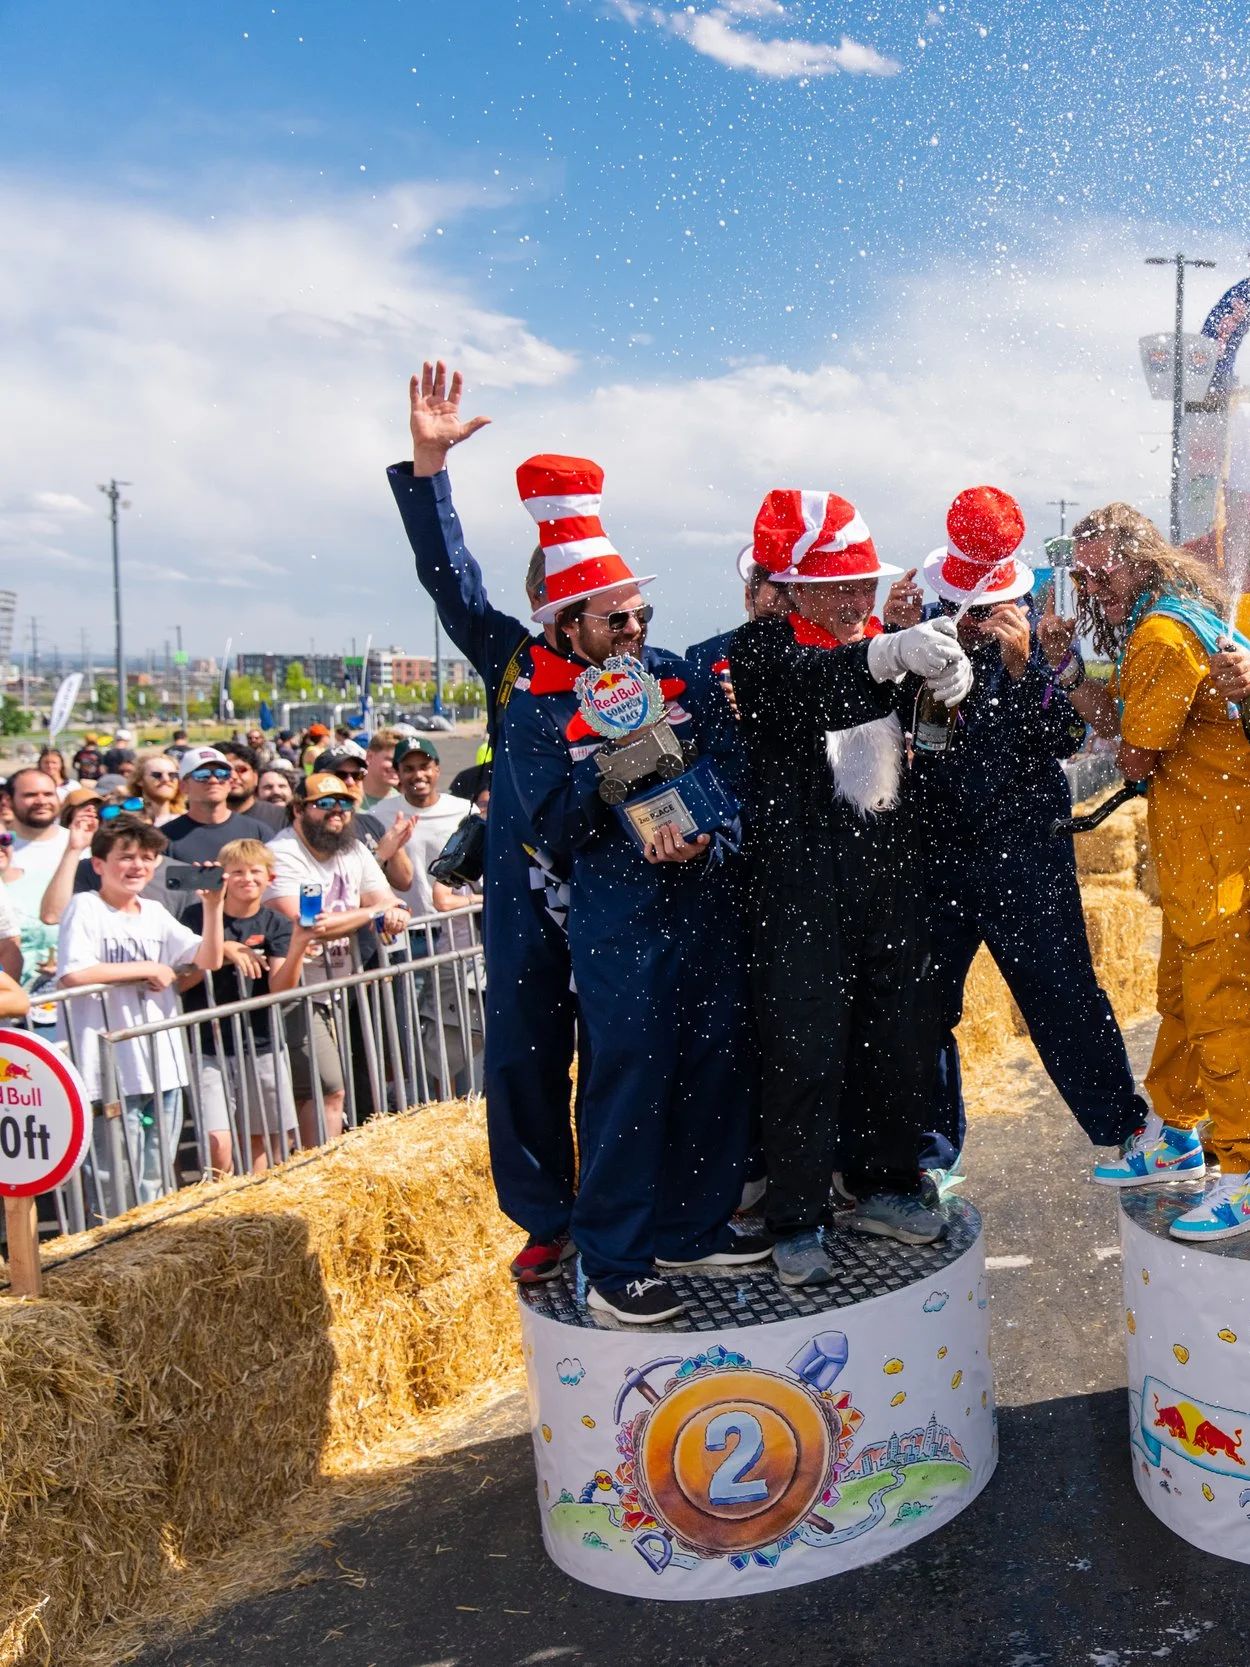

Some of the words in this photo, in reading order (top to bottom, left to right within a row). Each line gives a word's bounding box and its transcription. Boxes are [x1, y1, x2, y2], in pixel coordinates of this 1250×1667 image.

[593, 691, 619, 711] Red
[617, 680, 643, 700] Bull
[606, 696, 642, 718] SOAPBOX
[620, 710, 640, 723] RACE
[650, 804, 675, 819] PLACE
[7, 1087, 42, 1107] Bull
[705, 1410, 770, 1506] 2
